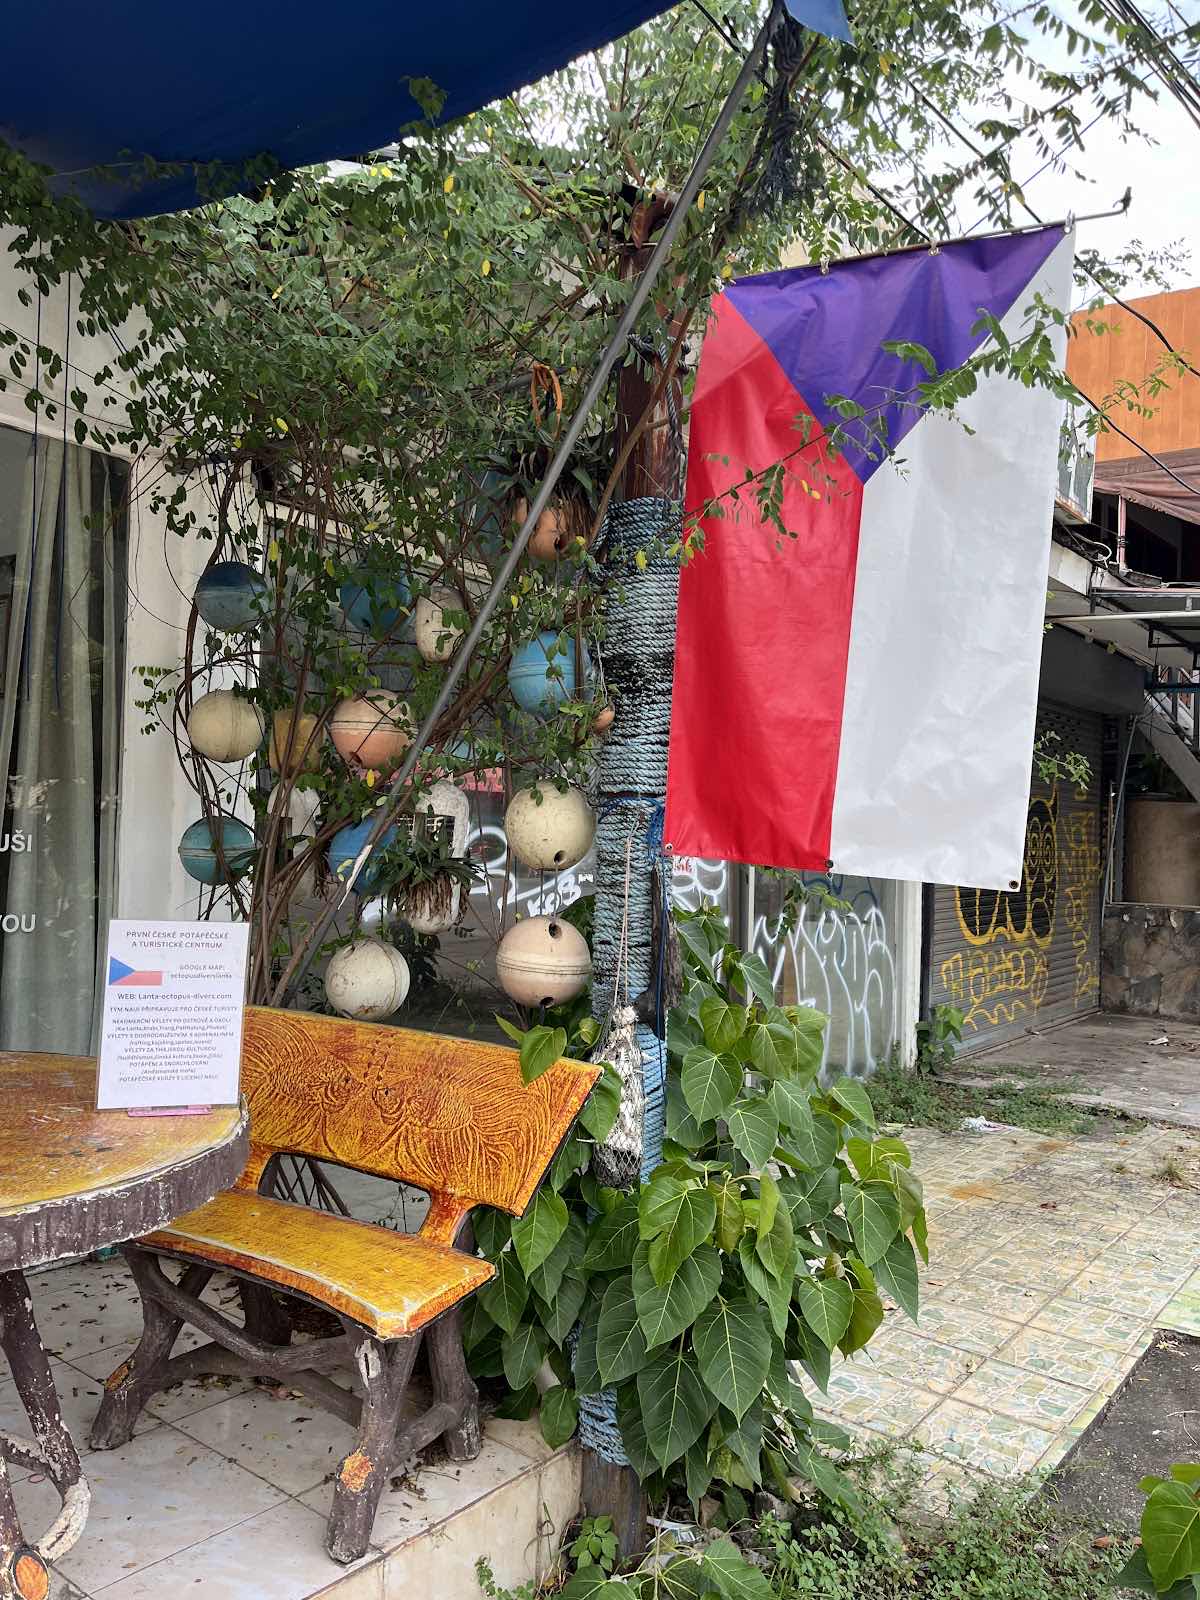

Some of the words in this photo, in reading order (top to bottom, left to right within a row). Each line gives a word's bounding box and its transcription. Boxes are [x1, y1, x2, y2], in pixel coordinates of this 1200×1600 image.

[0, 914, 36, 933] OU
[180, 931, 228, 939] POTÁPĚČSKÉ
[185, 941, 223, 949] CENTRUM
